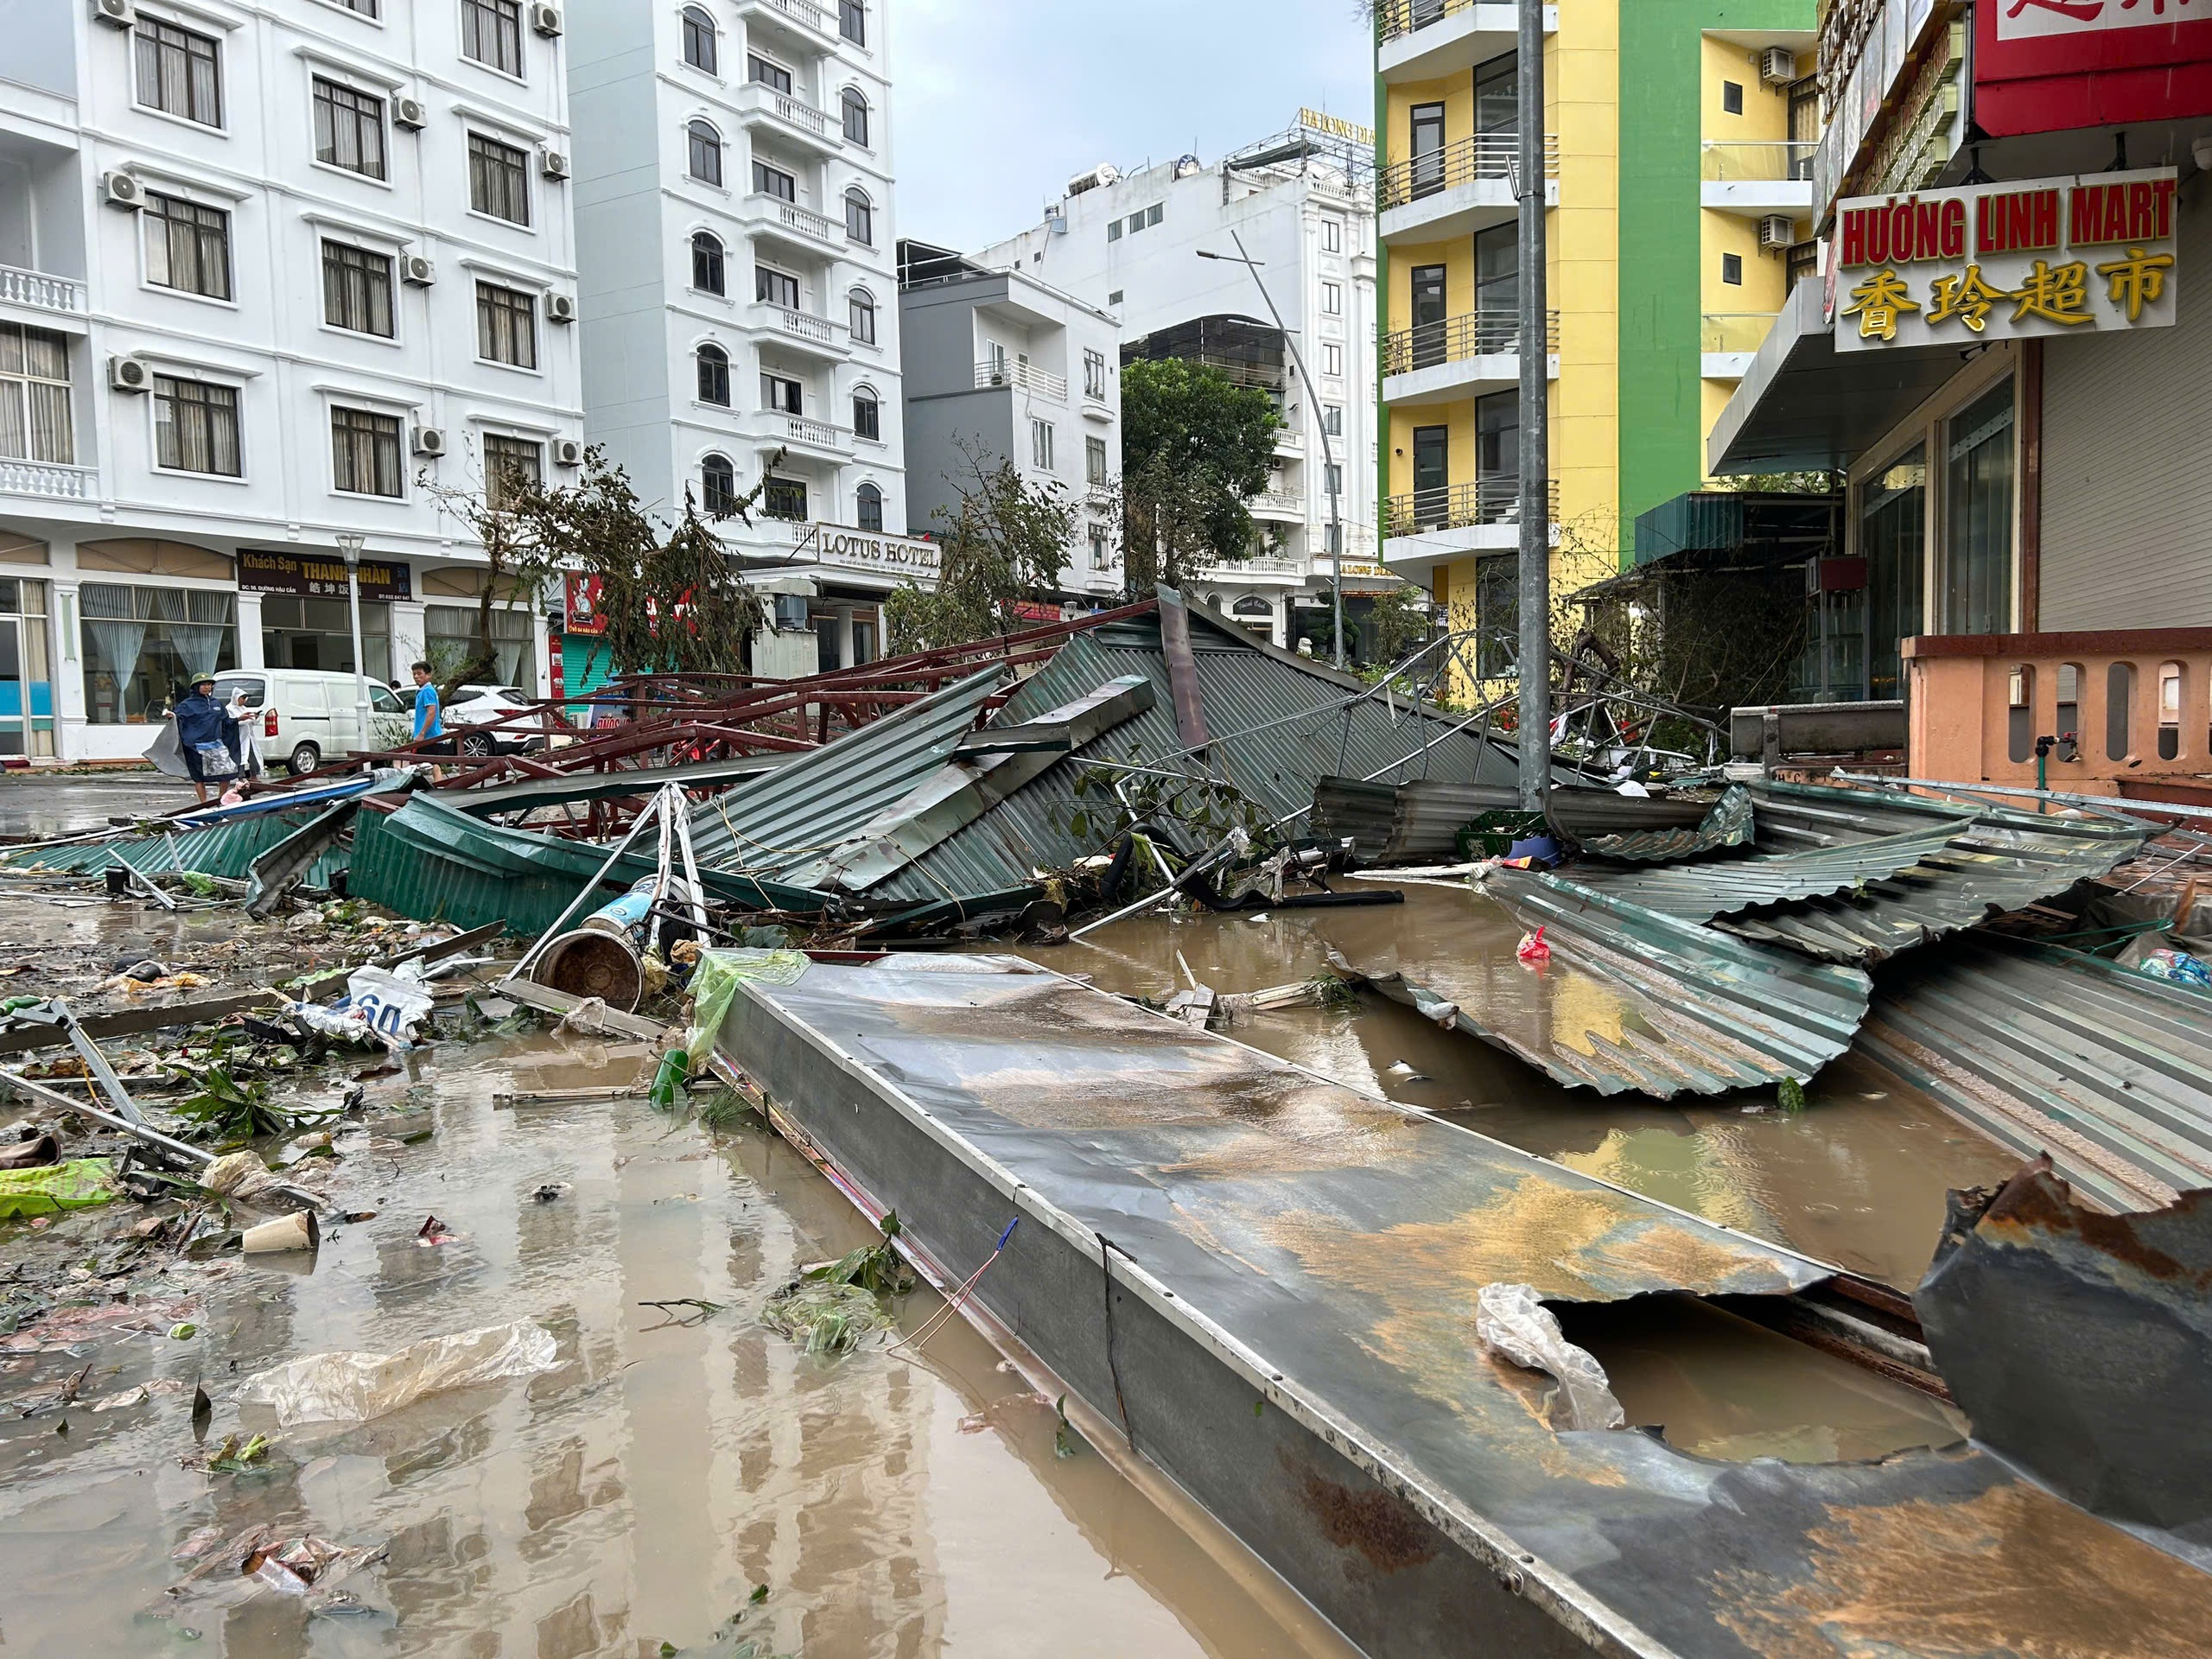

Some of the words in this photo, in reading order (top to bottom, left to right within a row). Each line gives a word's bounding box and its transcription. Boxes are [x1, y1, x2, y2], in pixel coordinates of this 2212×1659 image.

[1320, 112, 1353, 139] LONG
[1840, 194, 1966, 269] HƯƠNG
[1975, 188, 2060, 256] LINH
[2068, 180, 2176, 247] MART
[1841, 247, 2176, 341] 香玲超市
[822, 532, 881, 560] LOTUS
[884, 542, 939, 568] HOTEL
[242, 553, 276, 571] Khách
[277, 556, 297, 575] Sạn
[302, 563, 348, 582] THANH
[1339, 563, 1372, 575] ALONG
